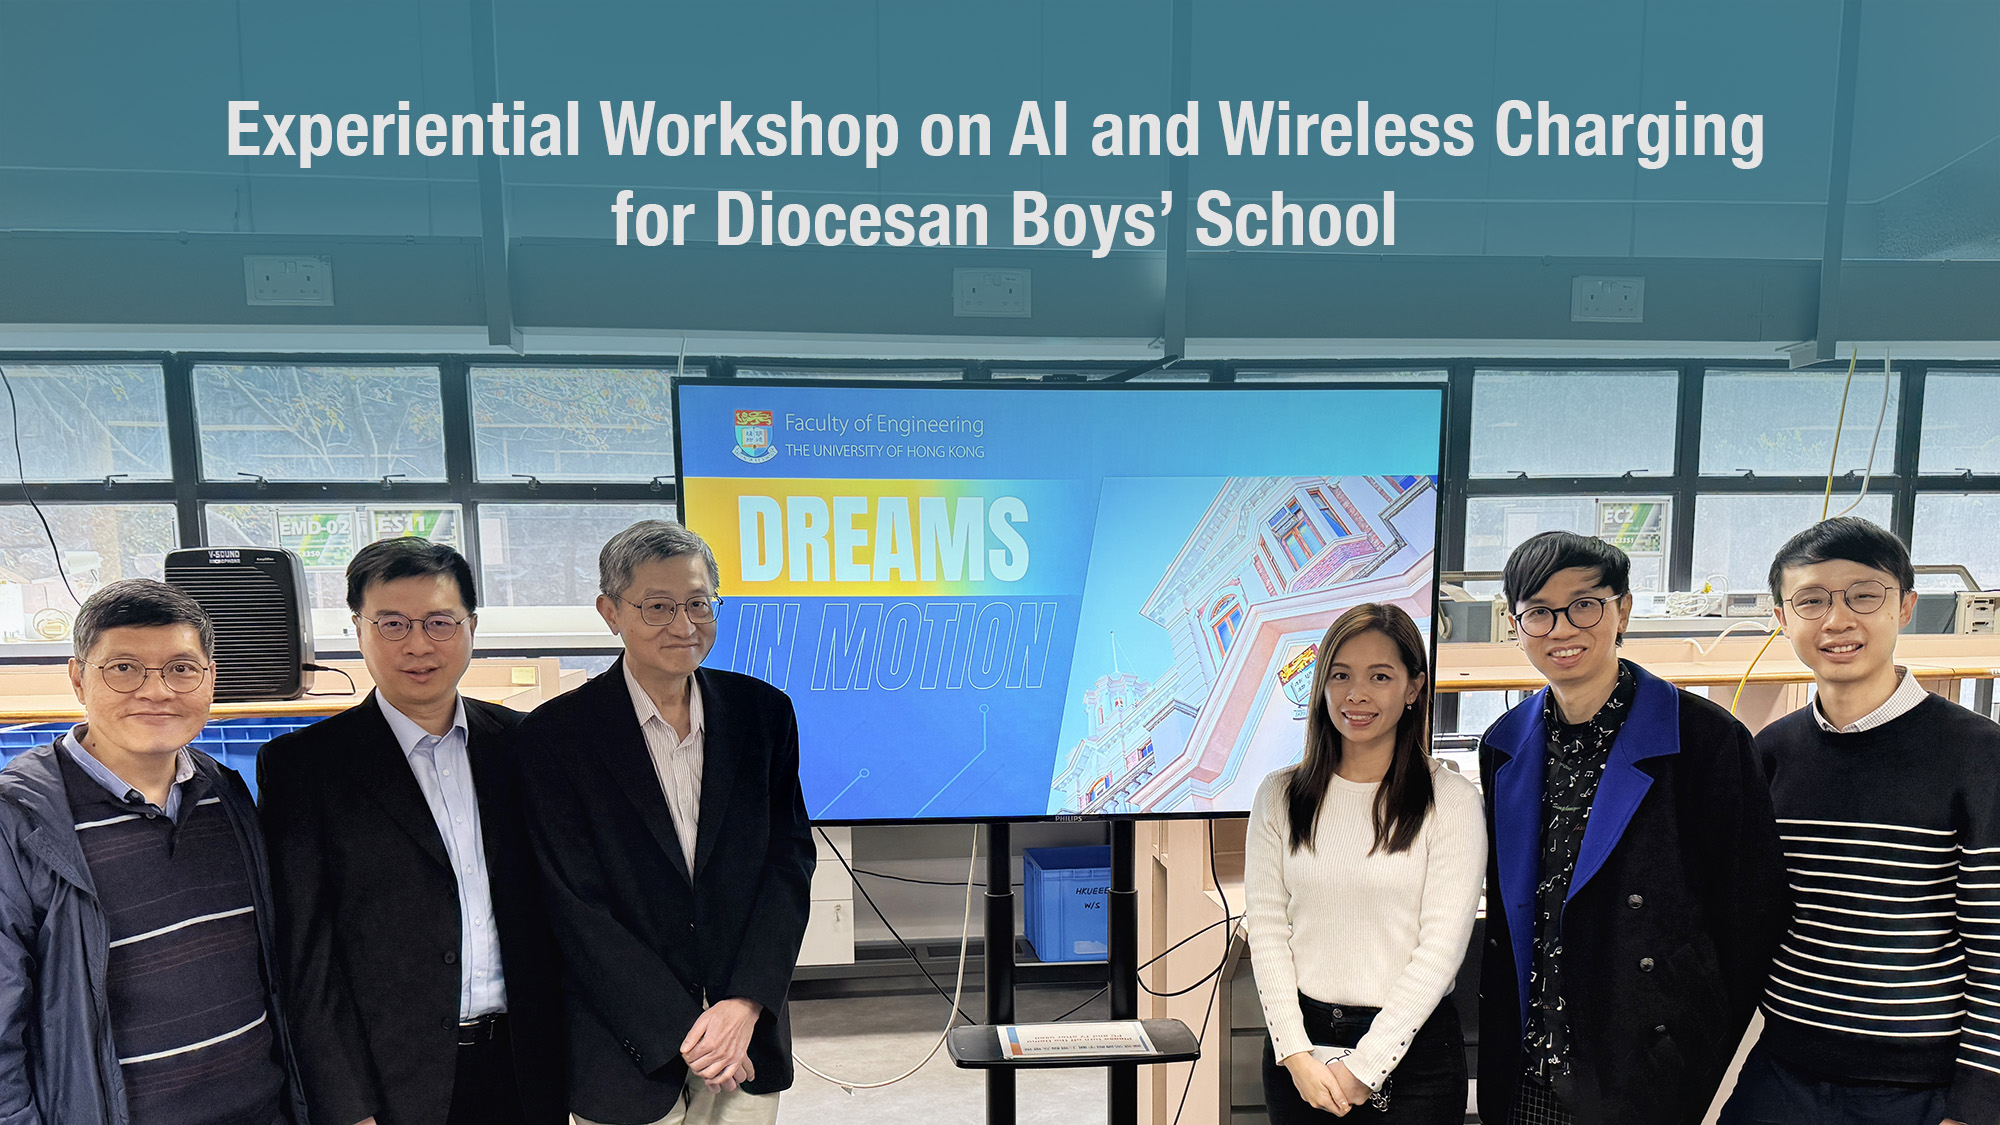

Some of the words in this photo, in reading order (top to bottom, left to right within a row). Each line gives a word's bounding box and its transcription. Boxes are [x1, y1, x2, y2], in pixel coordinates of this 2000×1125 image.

[785, 413, 849, 437] Faculty
[853, 413, 873, 432] of
[877, 414, 984, 438] Engineering
[785, 443, 810, 457] THE
[813, 444, 884, 457] UNIVERSITY
[886, 445, 904, 458] OF
[907, 445, 946, 458] HONG
[948, 446, 985, 459] KONG
[377, 515, 425, 533] ES11
[1604, 508, 1634, 524] EC2
[280, 520, 351, 536] EMD-02
[738, 495, 1030, 582] DREAMS
[207, 550, 241, 558] V-SOUND
[731, 603, 800, 690] IN
[811, 602, 1058, 691] MOTION
